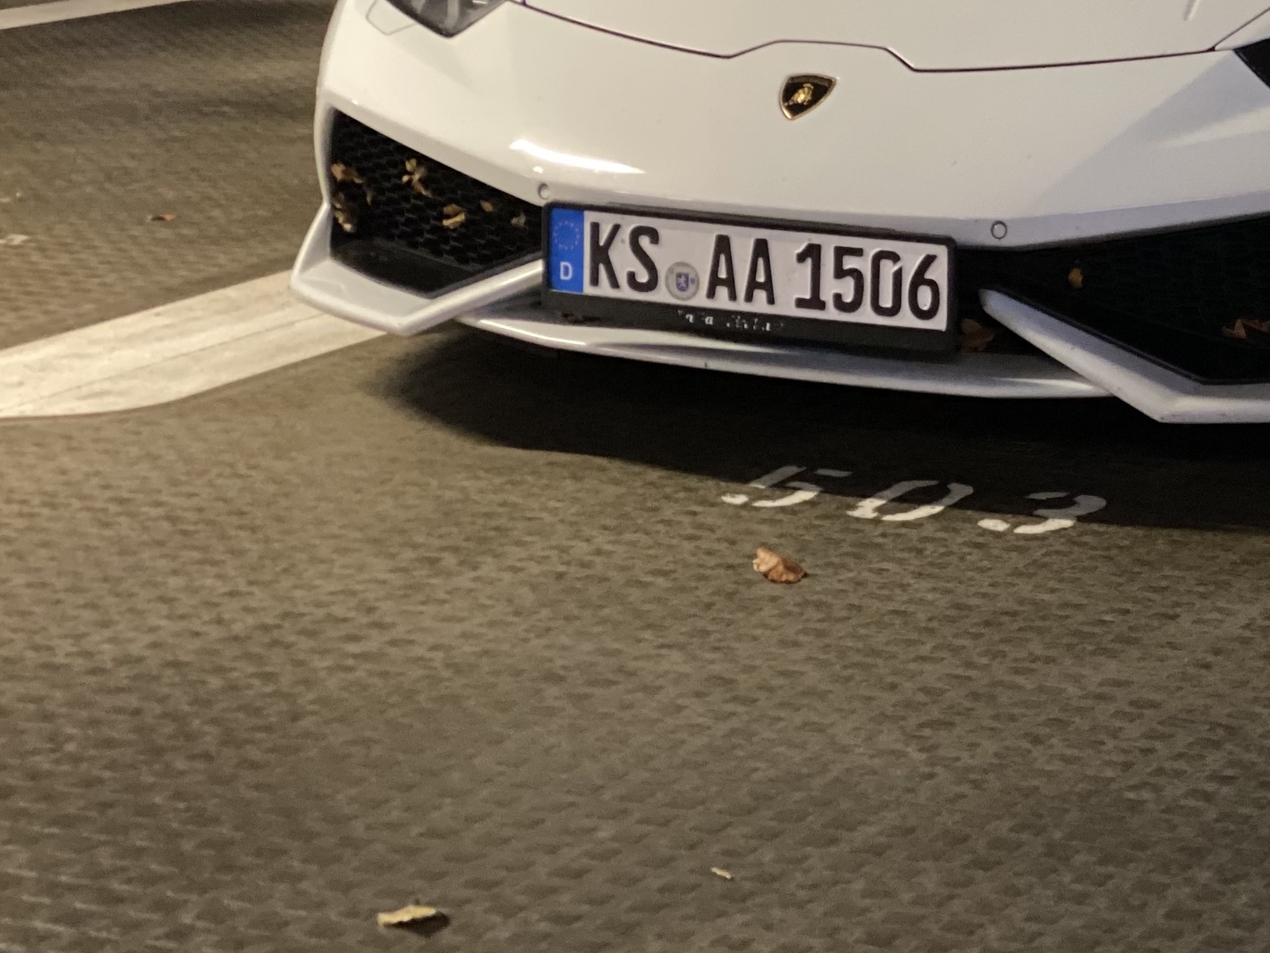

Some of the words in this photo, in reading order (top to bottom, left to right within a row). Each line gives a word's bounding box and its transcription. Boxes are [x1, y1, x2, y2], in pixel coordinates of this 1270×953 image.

[559, 261, 574, 281] D
[589, 221, 660, 293] KS
[706, 234, 776, 305] AA
[795, 243, 941, 321] 1506
[721, 465, 1107, 534] 503
